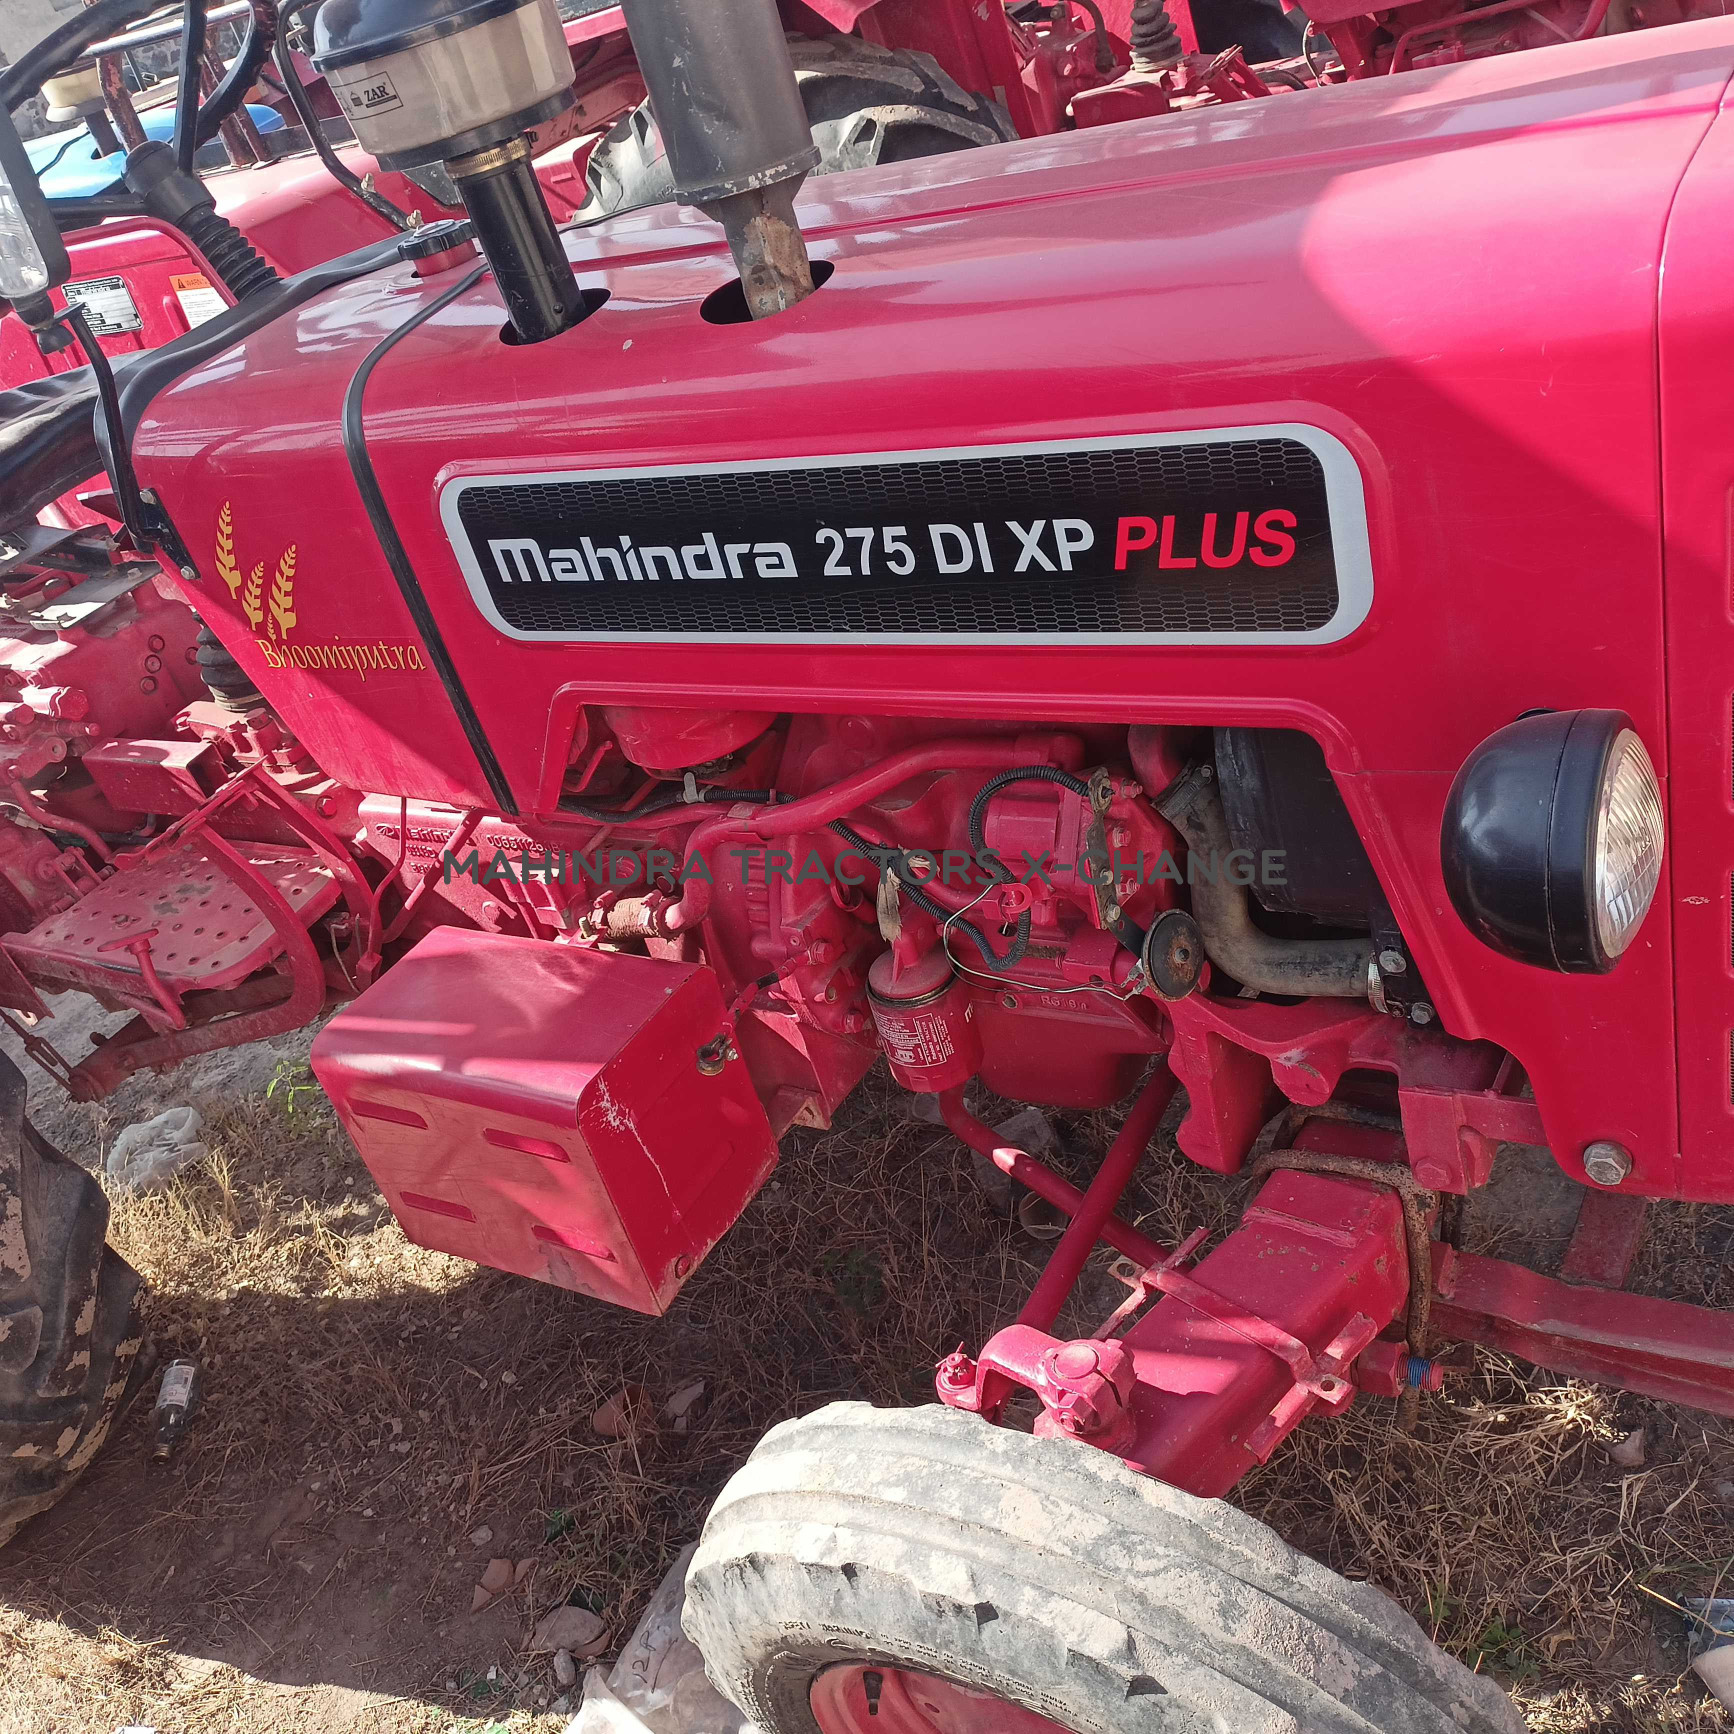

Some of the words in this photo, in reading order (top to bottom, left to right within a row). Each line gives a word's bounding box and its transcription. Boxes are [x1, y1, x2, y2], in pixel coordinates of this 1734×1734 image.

[363, 85, 390, 102] ZAR
[487, 532, 799, 583] Mahindra
[814, 525, 917, 577] 275
[927, 522, 995, 575] DI
[1005, 518, 1095, 573] XP
[1114, 508, 1298, 571] PLUS
[254, 635, 427, 682] Bhoomiputra
